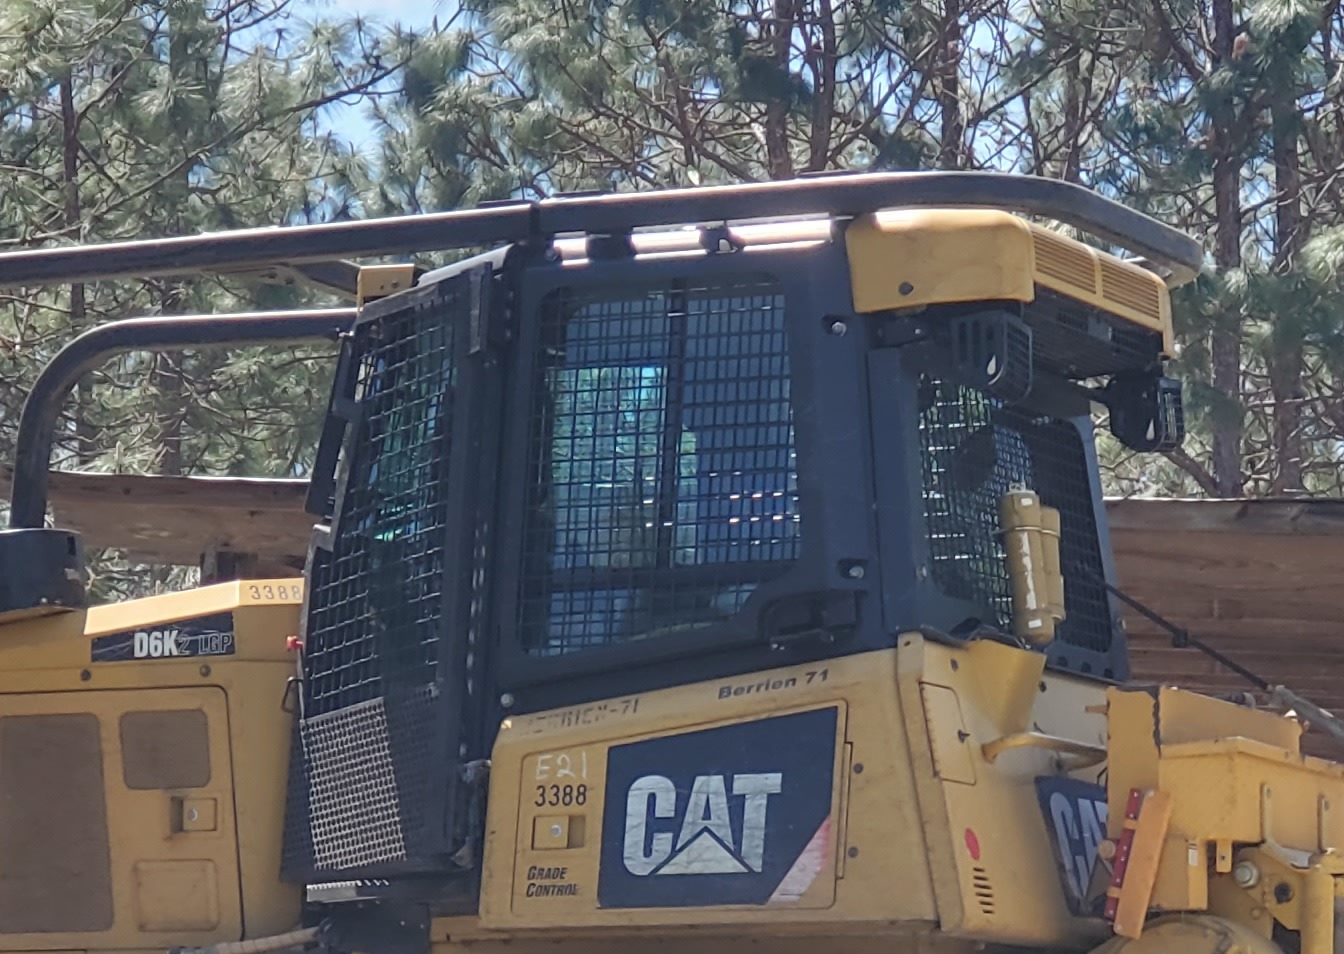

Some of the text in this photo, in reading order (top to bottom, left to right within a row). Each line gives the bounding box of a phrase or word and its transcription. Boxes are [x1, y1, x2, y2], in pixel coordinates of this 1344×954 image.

[249, 585, 302, 600] 3388
[198, 635, 233, 653] LGP
[717, 669, 829, 700] Berrien 71
[534, 783, 588, 807] 3388
[623, 772, 783, 876] CAT
